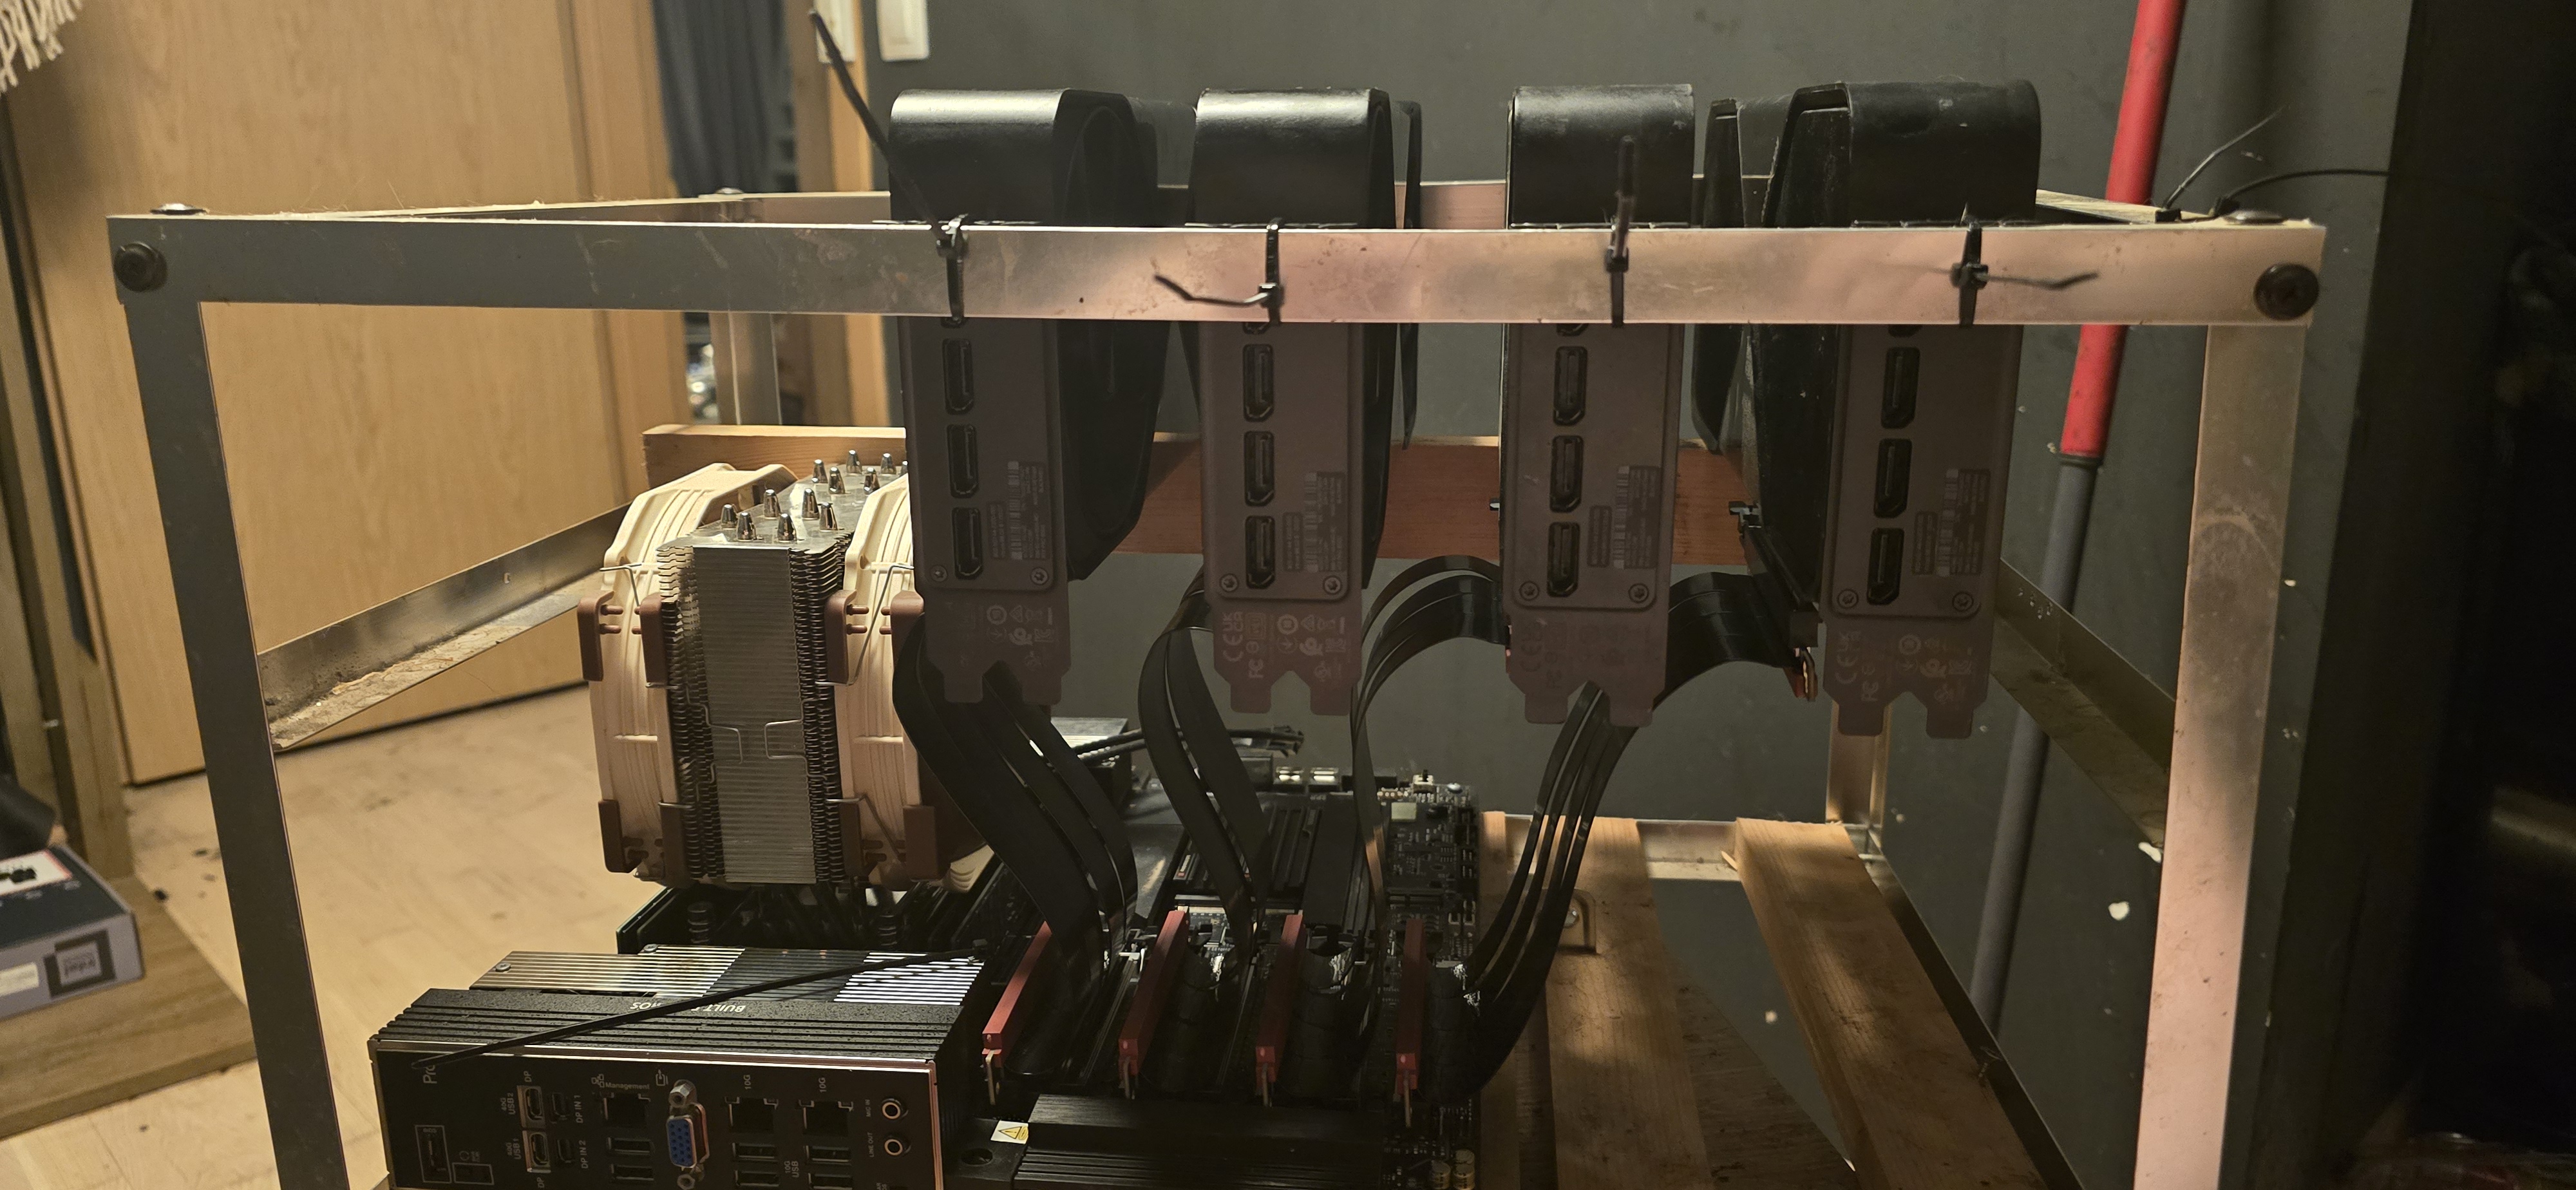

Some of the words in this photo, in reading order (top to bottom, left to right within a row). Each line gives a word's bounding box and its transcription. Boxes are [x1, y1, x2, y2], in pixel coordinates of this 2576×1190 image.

[1222, 633, 1245, 663] CE
[1835, 654, 1859, 685] CE
[703, 1003, 746, 1013] BUILT
[523, 1071, 532, 1082] DP
[743, 1074, 752, 1090] 10G
[605, 1082, 650, 1091] Management
[818, 1077, 827, 1093] 10G
[507, 1097, 516, 1115] USB
[574, 1101, 582, 1111] IN
[574, 1111, 584, 1124] DP
[513, 1143, 522, 1160] USB
[579, 1147, 587, 1156] IN
[580, 1157, 589, 1169] DP
[791, 1160, 800, 1178] USB
[536, 1176, 545, 1188] DP
